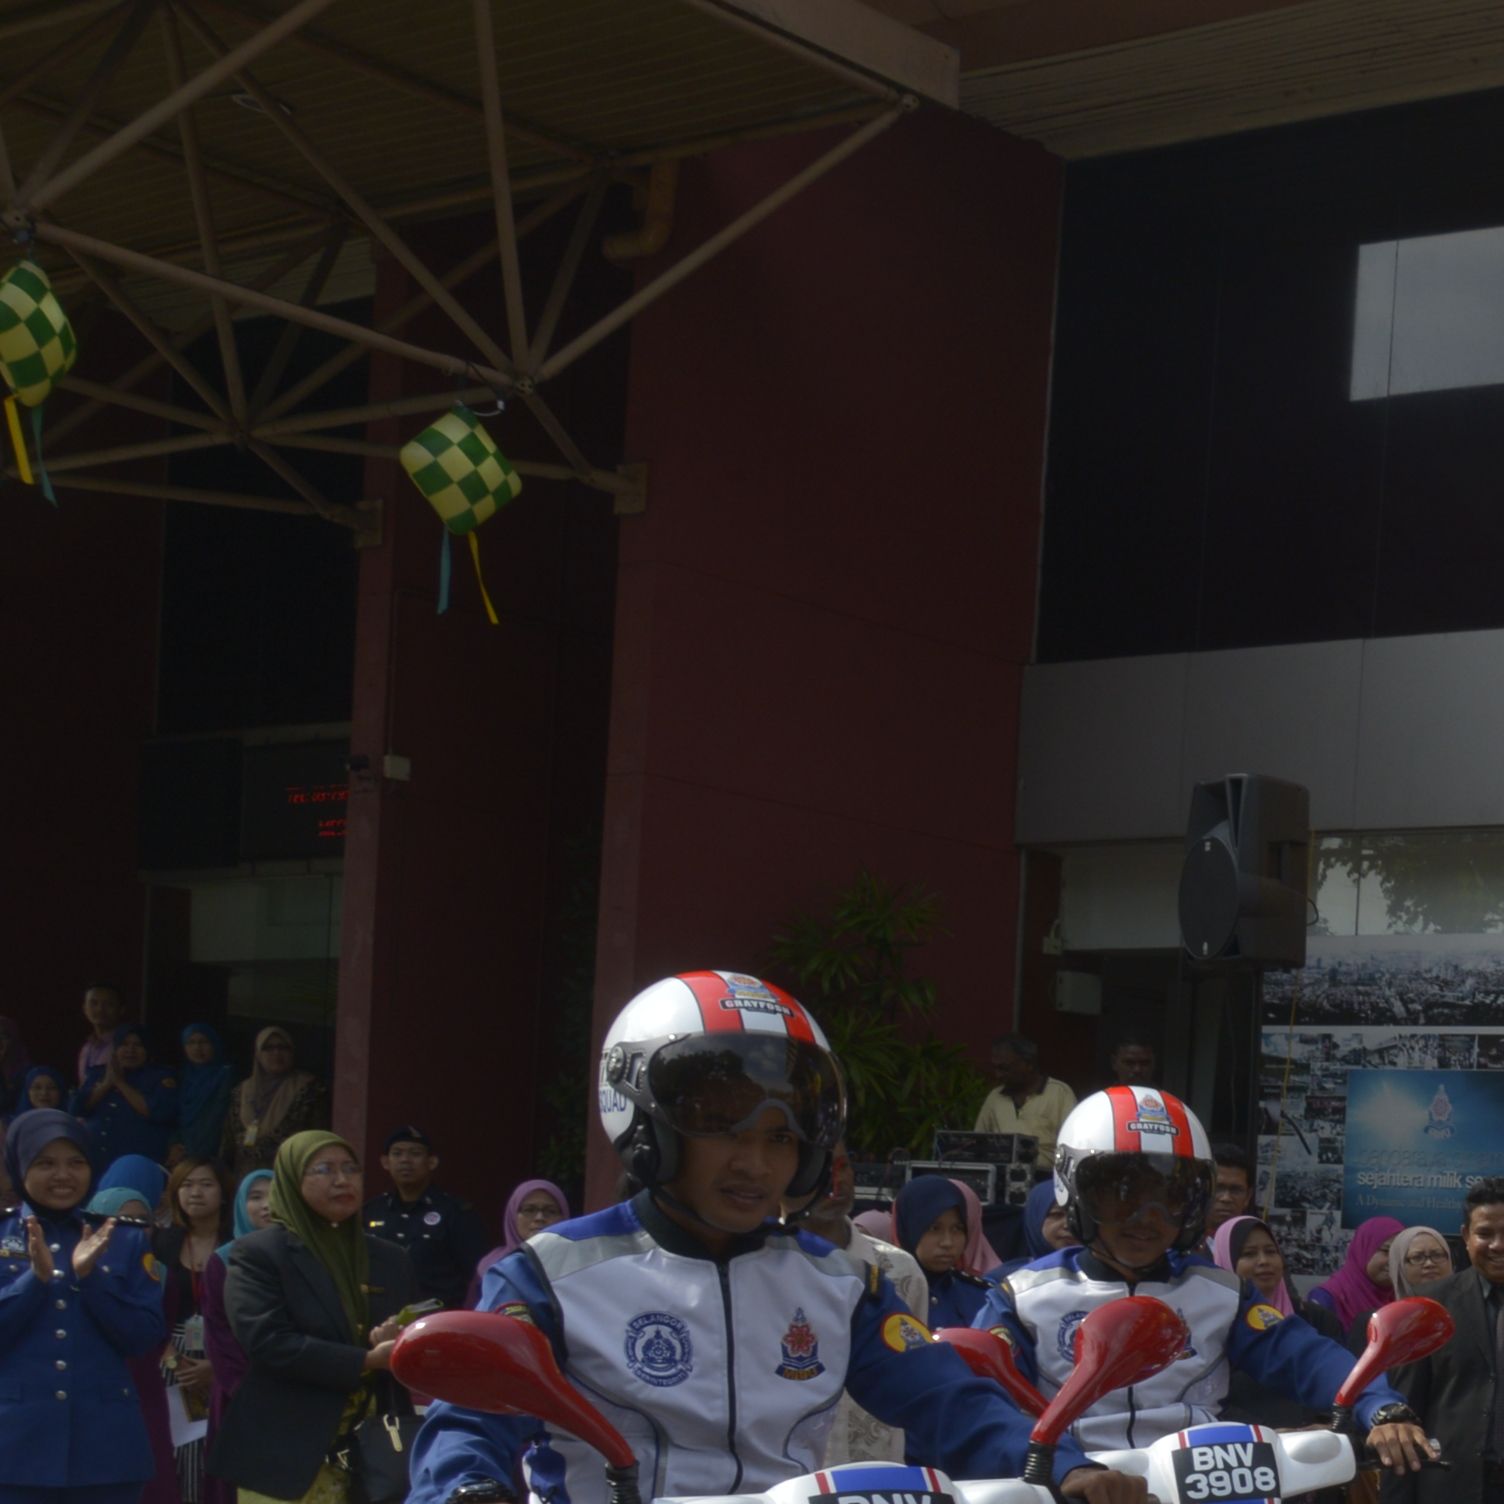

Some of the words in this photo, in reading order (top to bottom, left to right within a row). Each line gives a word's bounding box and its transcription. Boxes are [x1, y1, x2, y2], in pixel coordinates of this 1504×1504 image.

[600, 1090, 627, 1113] QUAD
[1192, 1443, 1254, 1472] BNV
[1185, 1466, 1277, 1500] 3908
